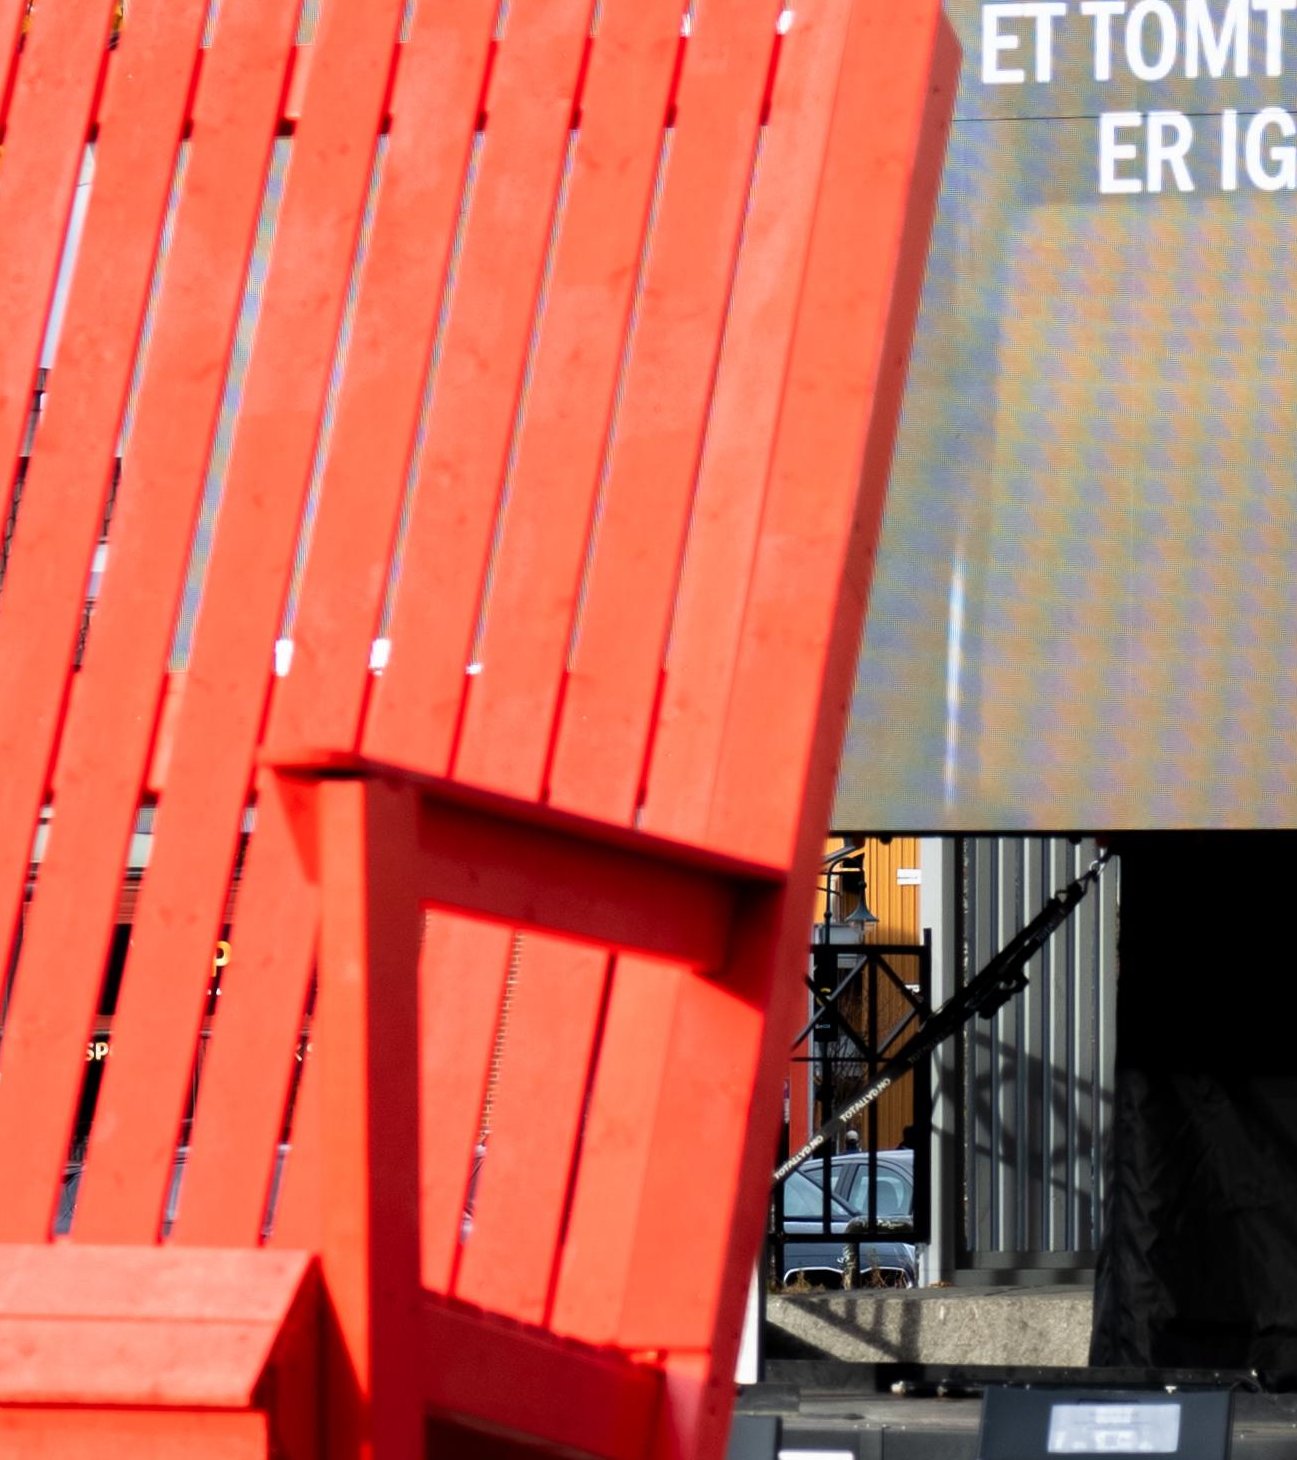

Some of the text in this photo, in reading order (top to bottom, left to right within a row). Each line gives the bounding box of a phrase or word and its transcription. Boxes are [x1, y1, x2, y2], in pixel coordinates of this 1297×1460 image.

[981, 2, 1067, 84] ET
[1099, 111, 1195, 194] ER
[839, 1077, 891, 1122] TOTALLYD.NO
